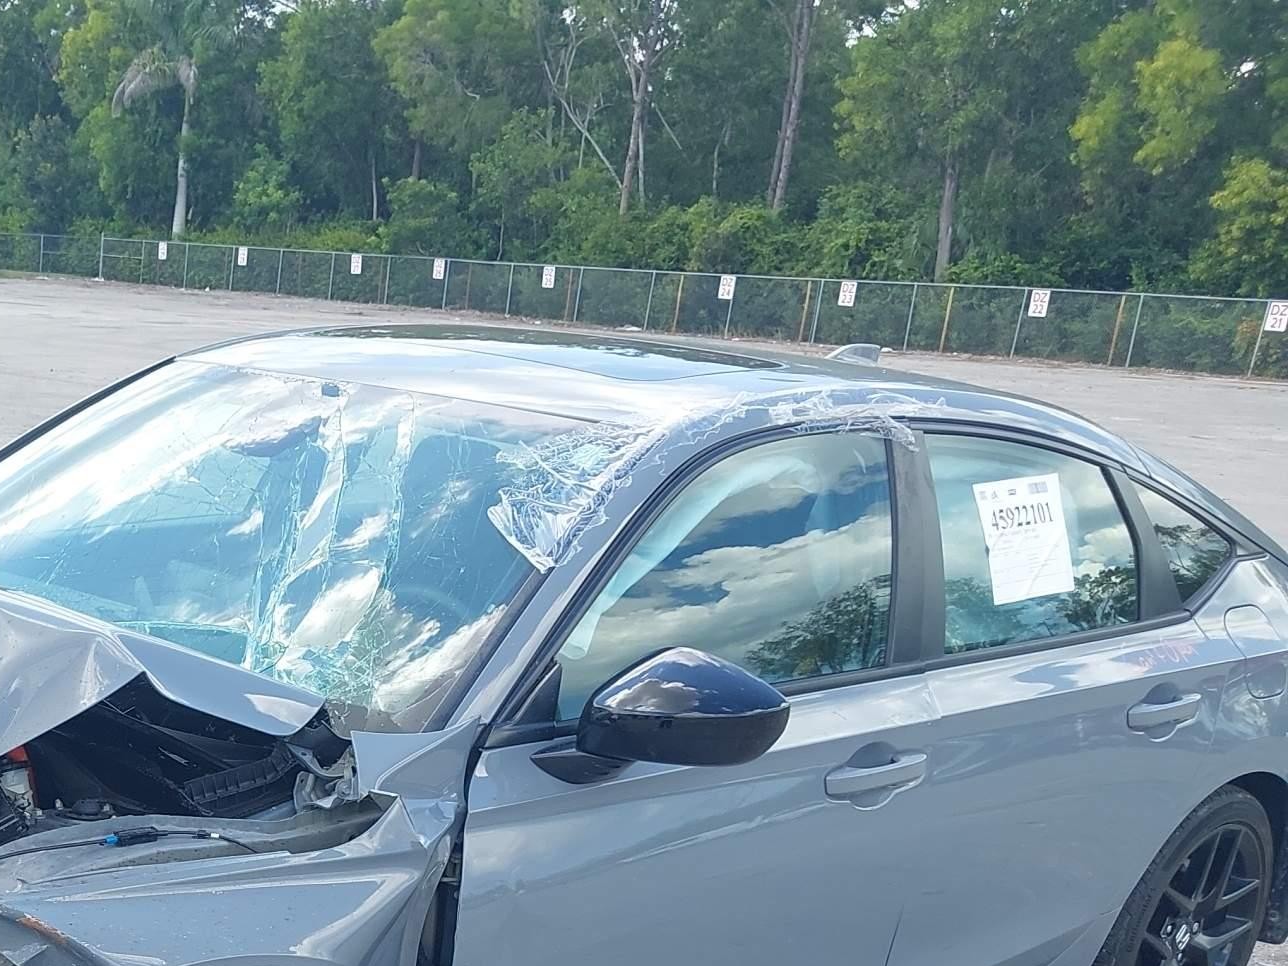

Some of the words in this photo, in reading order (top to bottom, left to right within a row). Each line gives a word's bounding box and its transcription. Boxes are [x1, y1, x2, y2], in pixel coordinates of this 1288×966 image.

[722, 277, 734, 287] DZ
[720, 287, 731, 297] 24
[842, 283, 855, 294] DZ
[841, 294, 853, 304] 23
[1033, 292, 1048, 303] DZ
[1032, 303, 1044, 315] 22
[1270, 304, 1288, 316] DZ
[1270, 317, 1283, 329] 21
[992, 502, 1053, 531] 45922101
